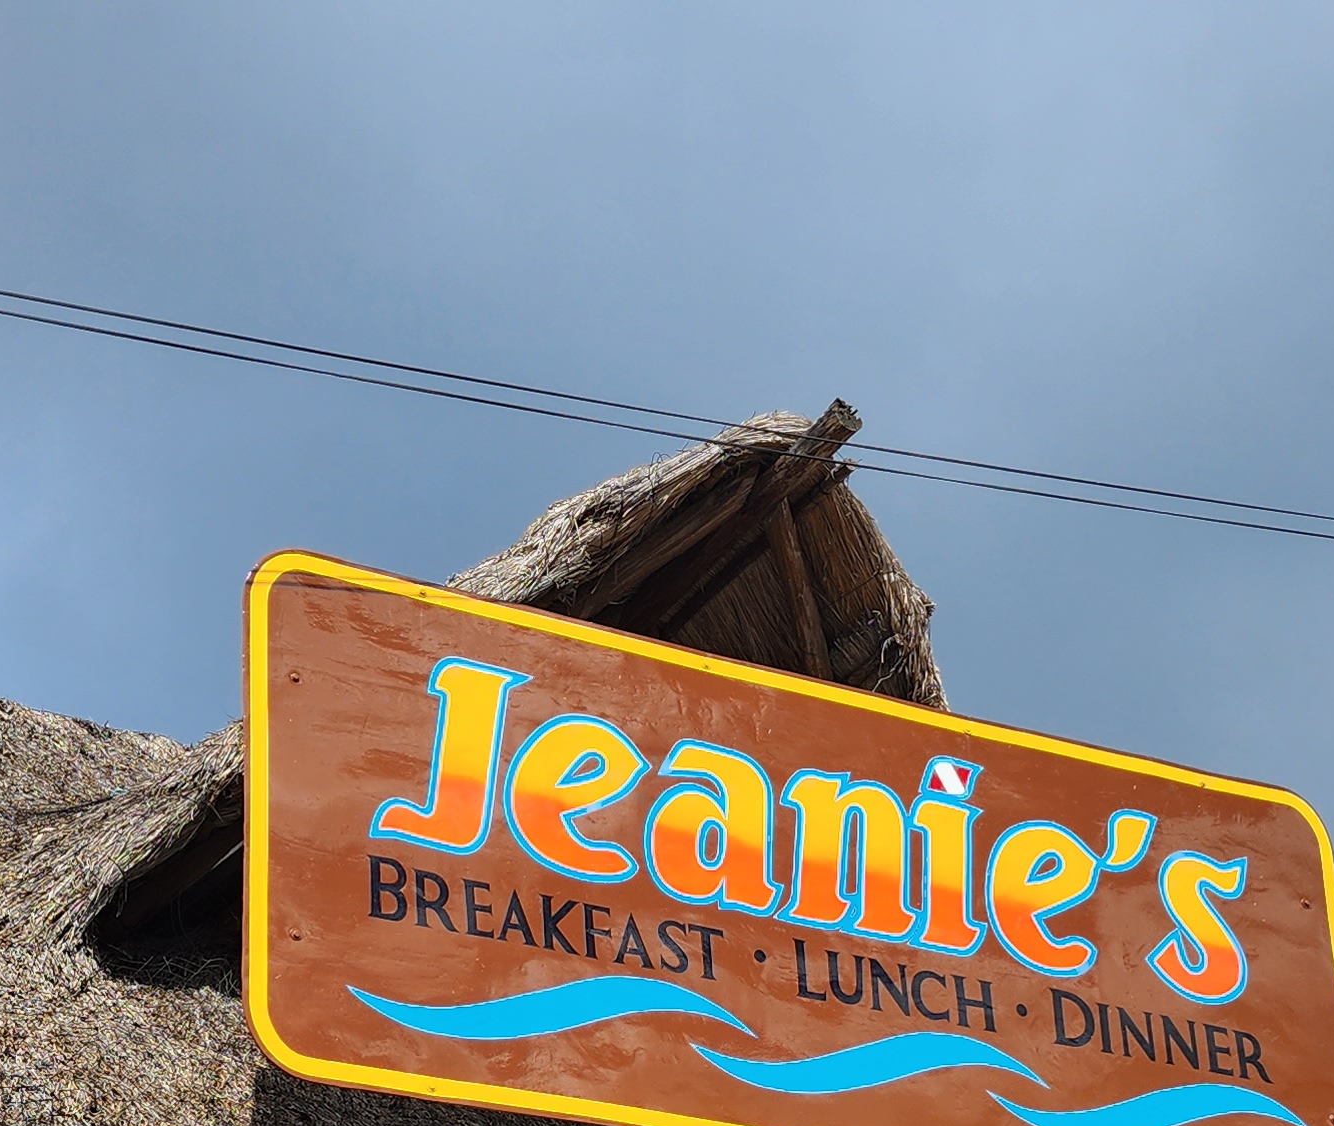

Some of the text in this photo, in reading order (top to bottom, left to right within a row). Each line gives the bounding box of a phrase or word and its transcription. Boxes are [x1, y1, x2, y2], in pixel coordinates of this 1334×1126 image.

[367, 853, 1273, 1086] BREAKFAST LUNCH DINNER
[369, 655, 1248, 1007] Jeanie's
